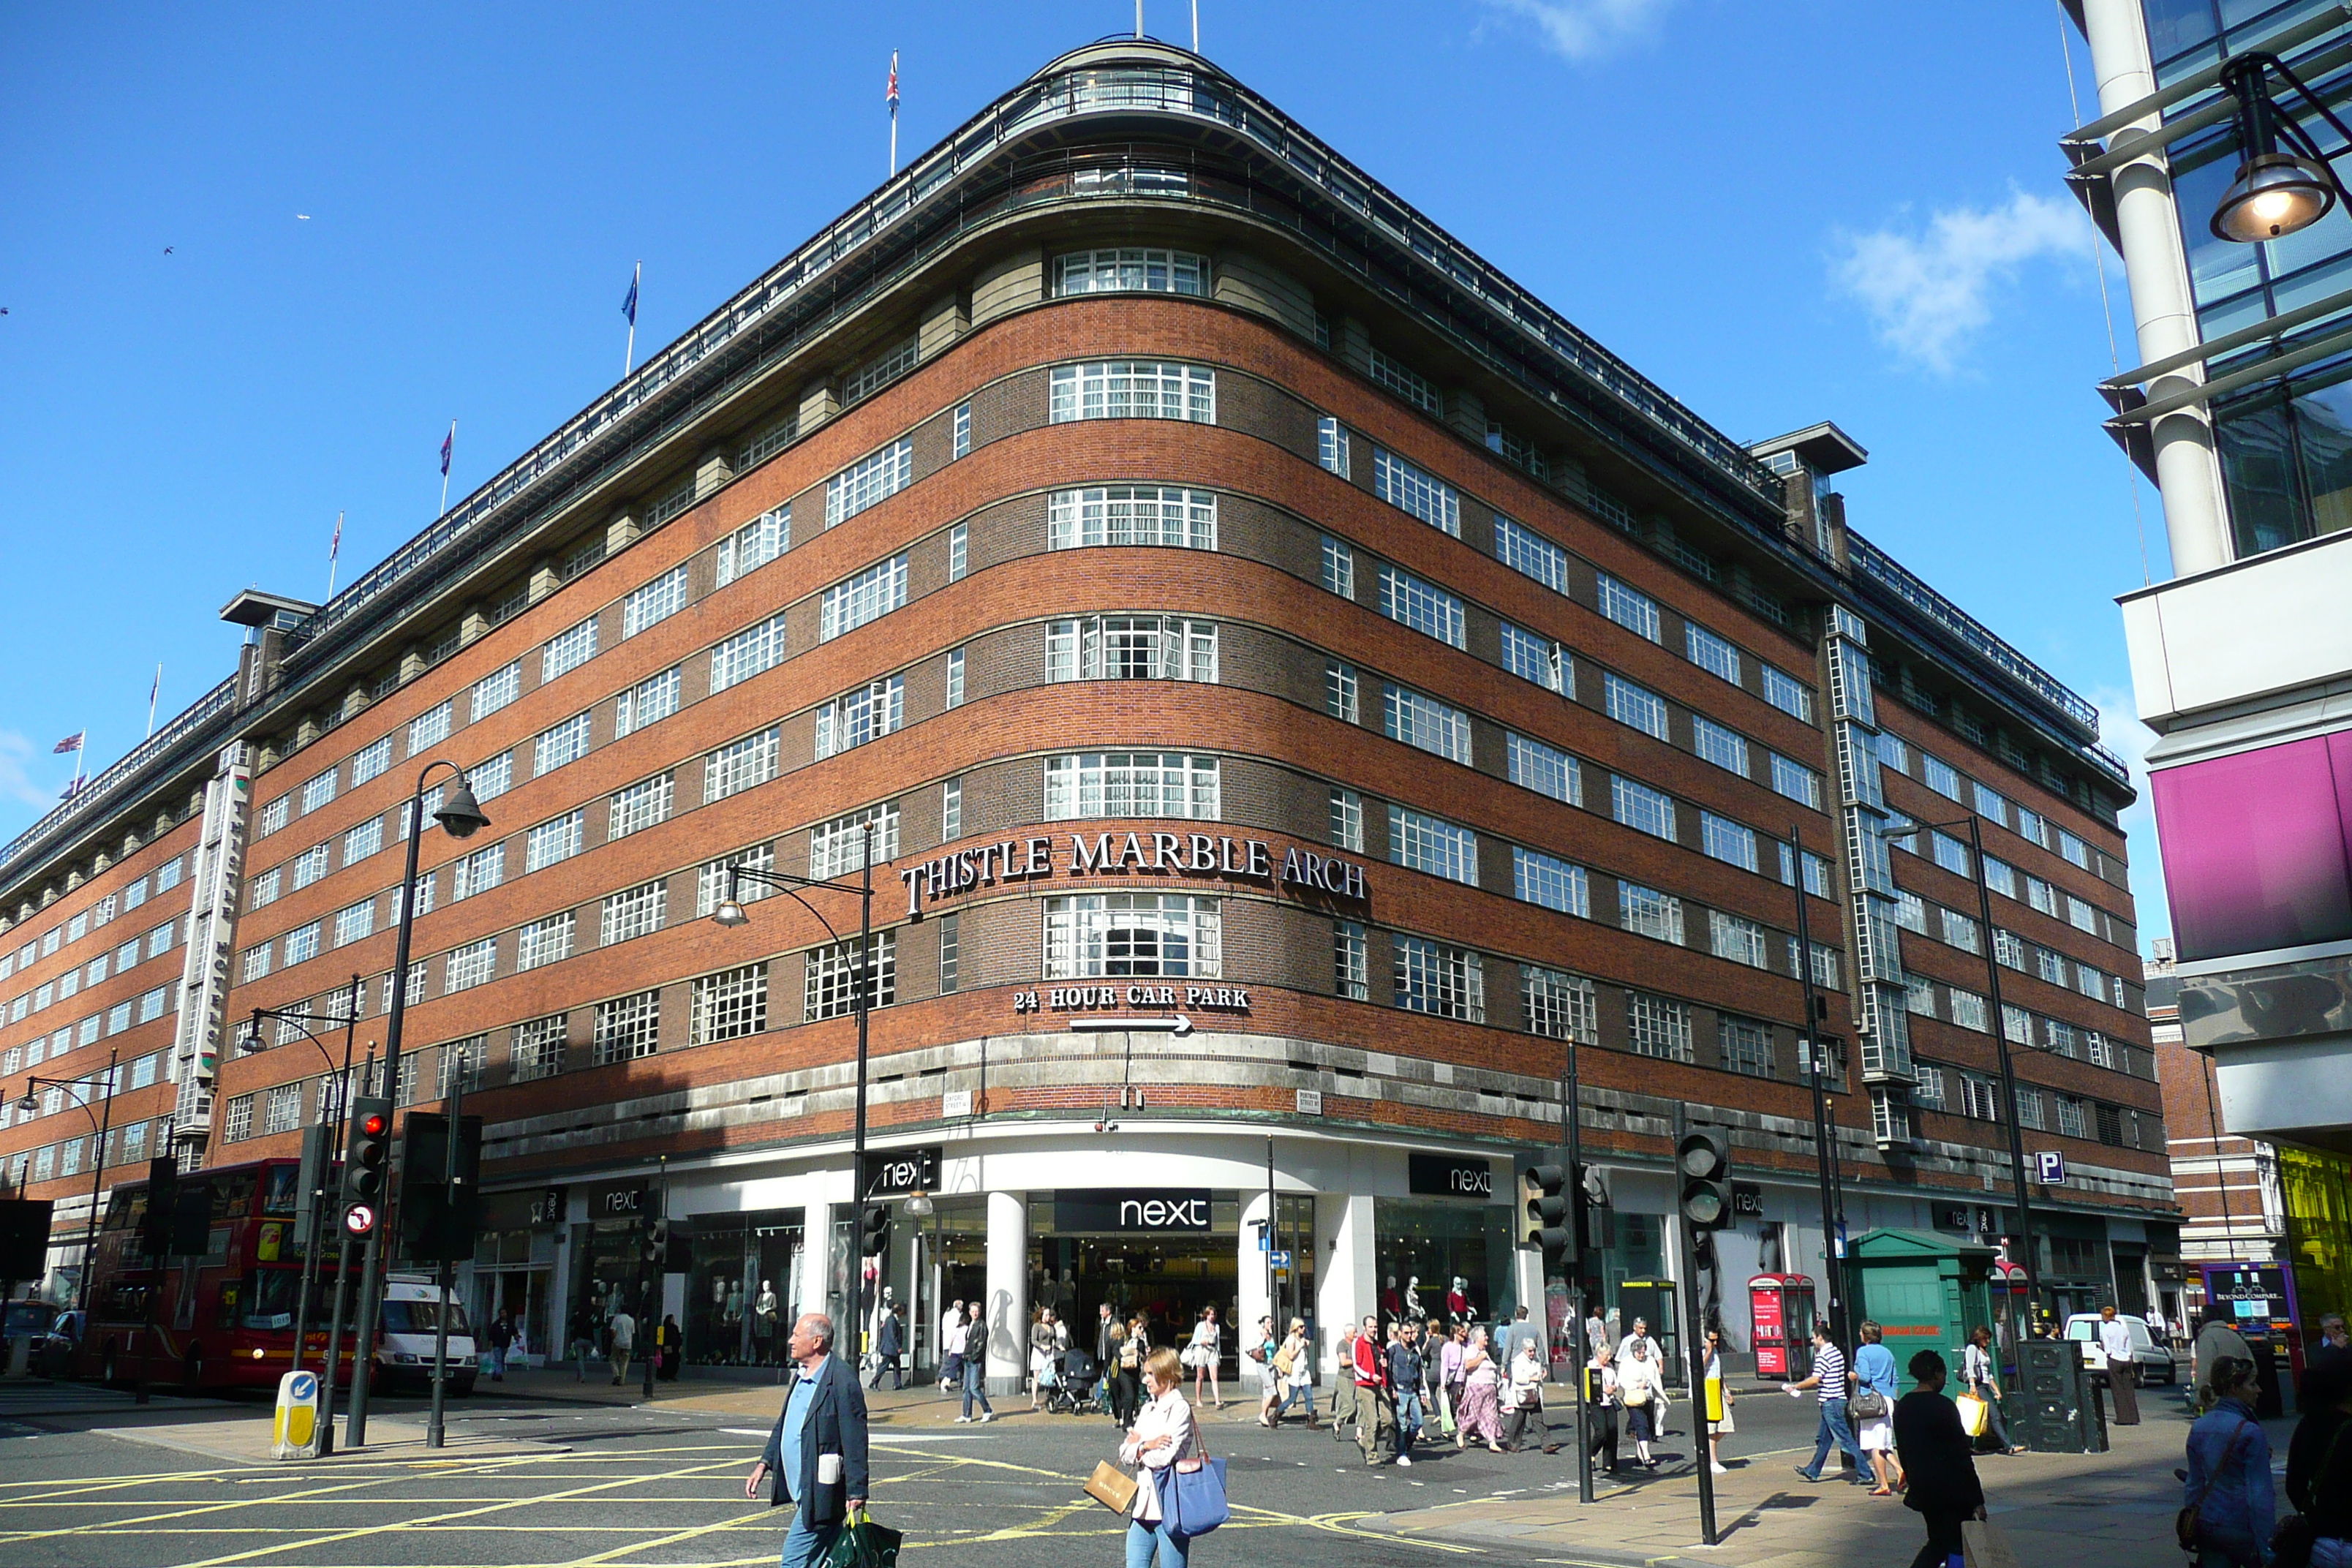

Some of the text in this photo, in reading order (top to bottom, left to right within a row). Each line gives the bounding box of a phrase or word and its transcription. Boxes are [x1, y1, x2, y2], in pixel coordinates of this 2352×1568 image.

[900, 831, 1366, 916] THISTLE MARBLE ARCH
[207, 799, 246, 1041] THISTLE HOTELS
[1014, 986, 1249, 1009] 24 HOUR CAR PARK
[945, 1094, 964, 1102] OXFORD
[945, 1101, 962, 1109] STREET
[2041, 1153, 2058, 1177] P
[1451, 1169, 1492, 1193] next
[547, 1192, 557, 1220] next
[606, 1190, 638, 1211] next
[1120, 1199, 1207, 1226] next
[1736, 1193, 1764, 1212] next
